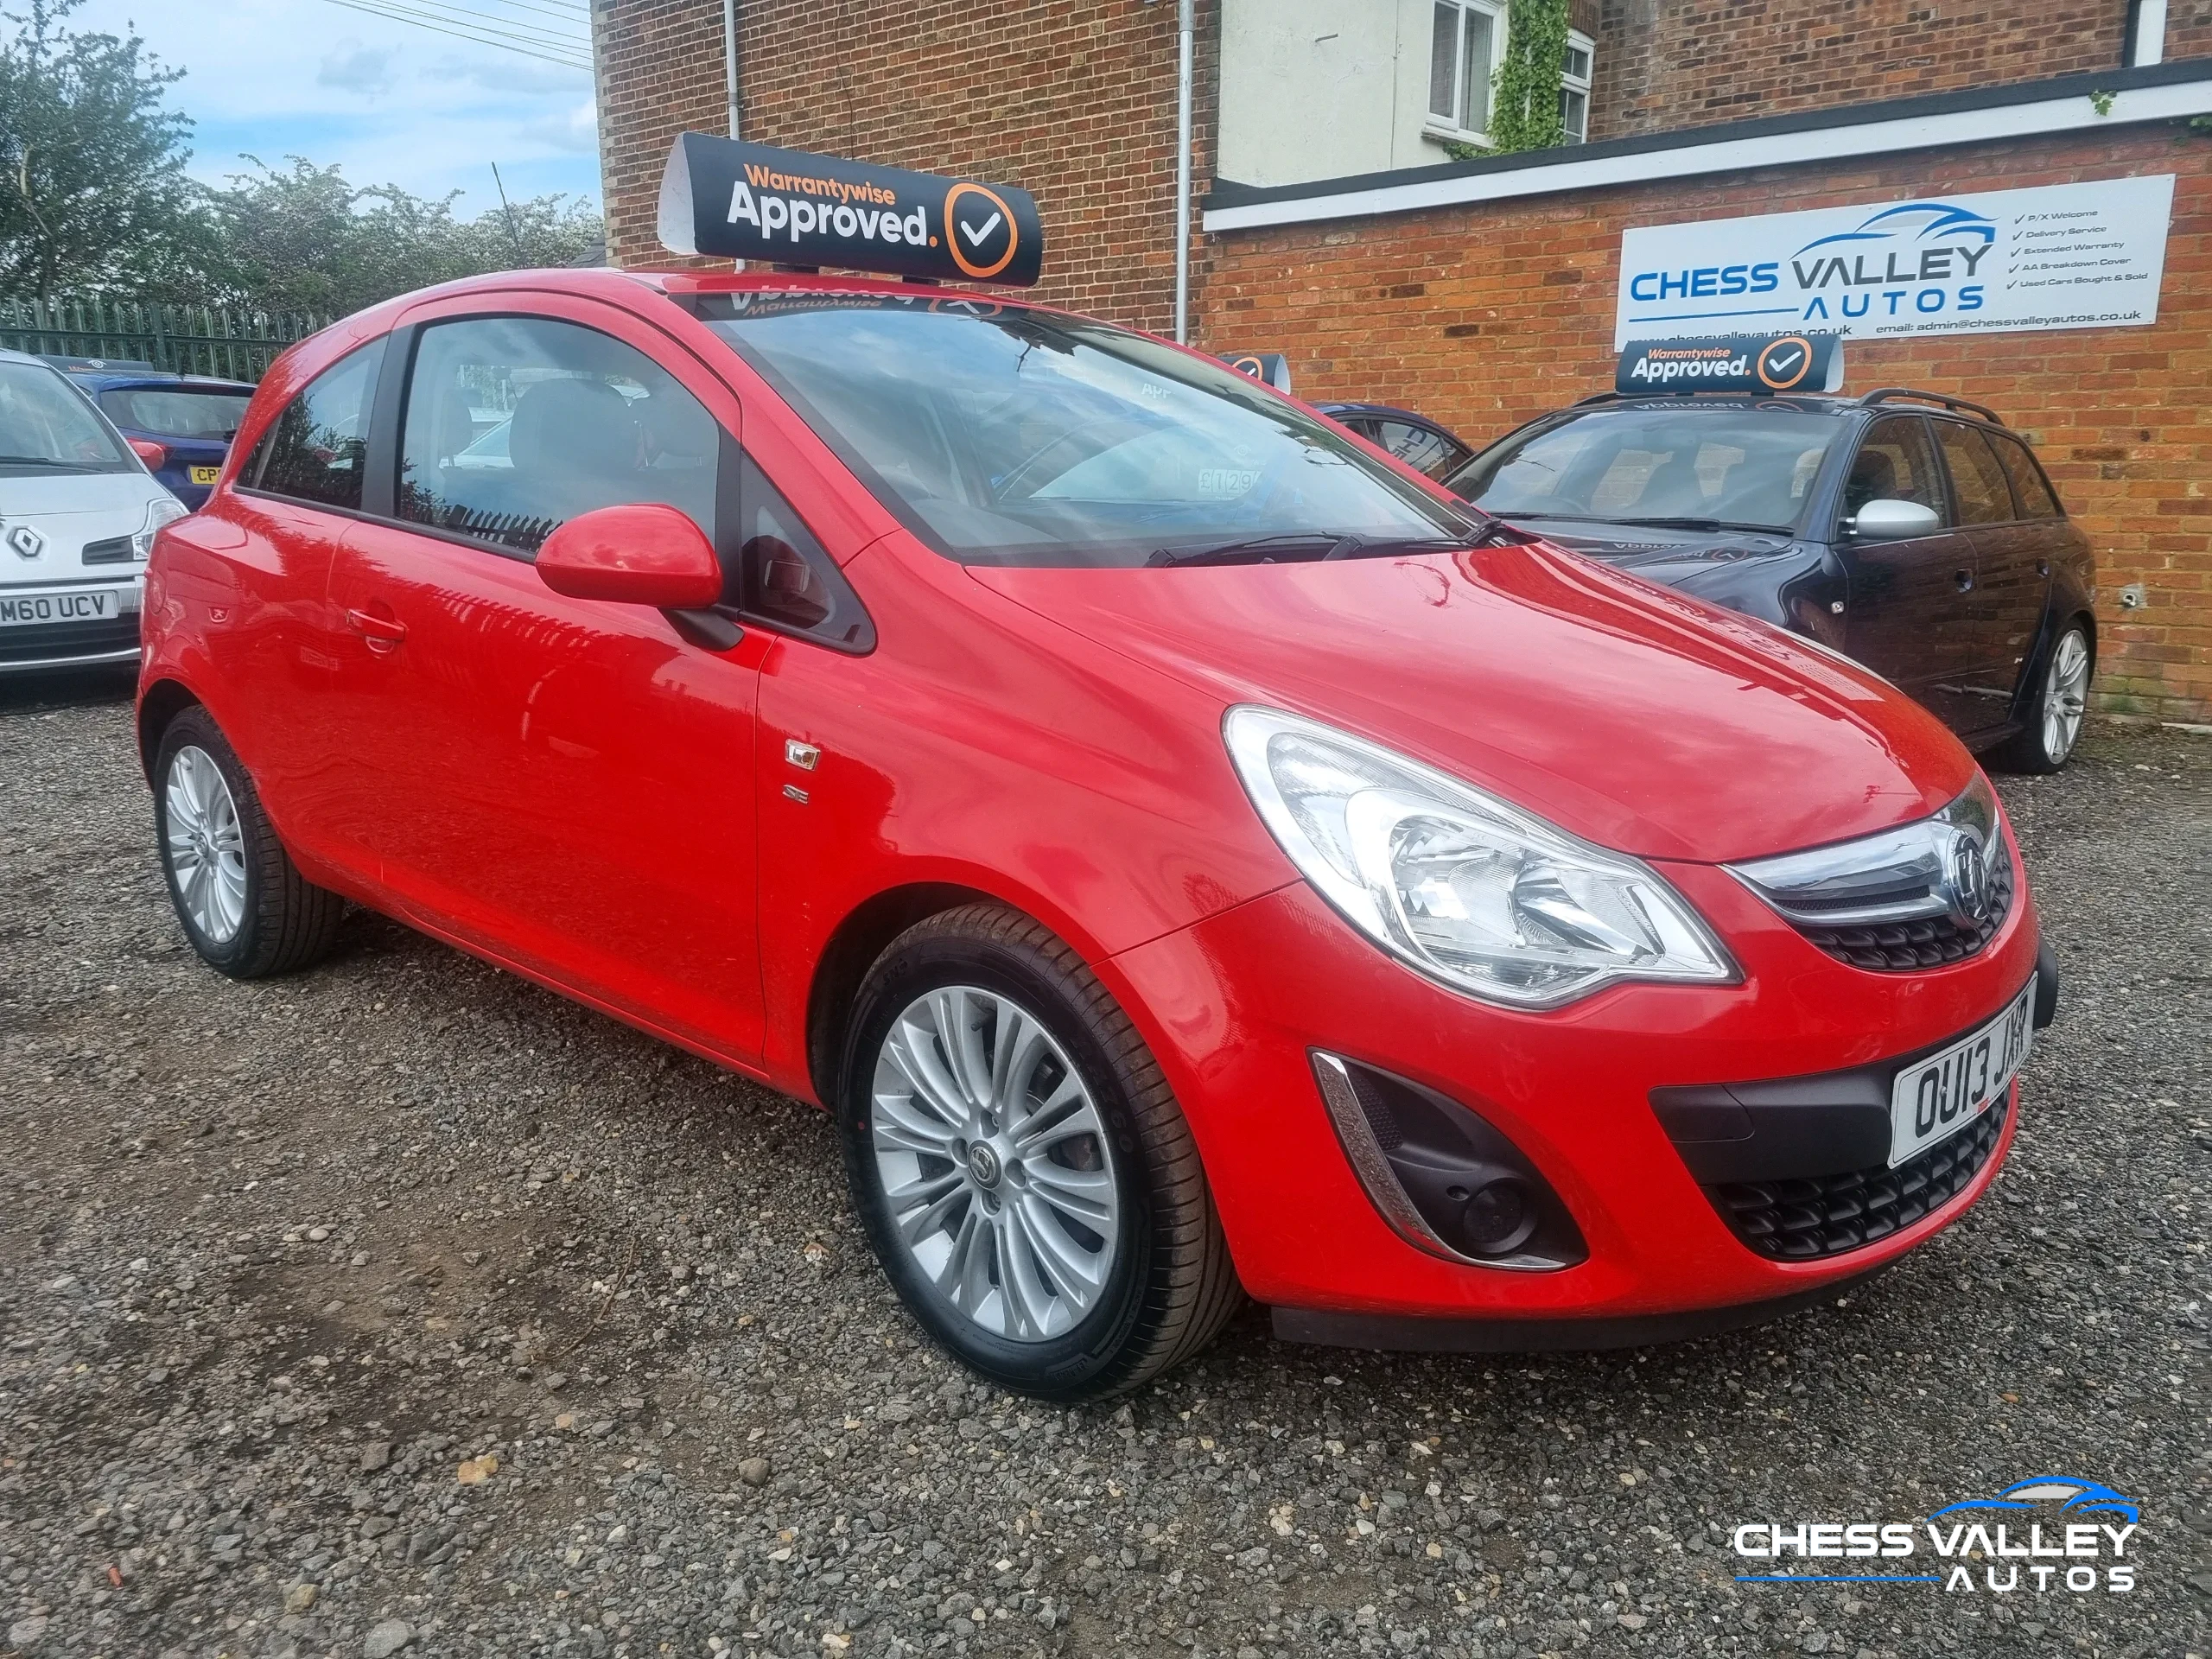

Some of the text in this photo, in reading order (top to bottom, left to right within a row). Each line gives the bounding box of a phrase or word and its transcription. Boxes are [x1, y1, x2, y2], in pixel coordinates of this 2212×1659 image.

[743, 163, 896, 205] Warrantywise
[727, 181, 938, 248] Approved.
[2028, 210, 2098, 222] P/X Welcome
[2025, 226, 2107, 238] Delivery Service
[2024, 241, 2125, 255] Extended Warranty
[1630, 245, 1993, 301] CHESS VALLEY
[2040, 260, 2098, 270] Breakdown
[2100, 257, 2132, 266] Cover
[2020, 279, 2046, 288] Used
[2048, 277, 2073, 286] Cars
[2075, 274, 2113, 285] Bought
[2125, 272, 2149, 281] Sold
[1802, 285, 1984, 321] AUTOS
[1876, 310, 2142, 334] email: admin@chessvalleyautos.co.uk
[1648, 347, 1731, 360] Warrantywise
[1630, 355, 1751, 383] Approved.
[0, 594, 105, 621] M60 UCV
[782, 784, 809, 804] SE
[1915, 1036, 1991, 1139] OU13
